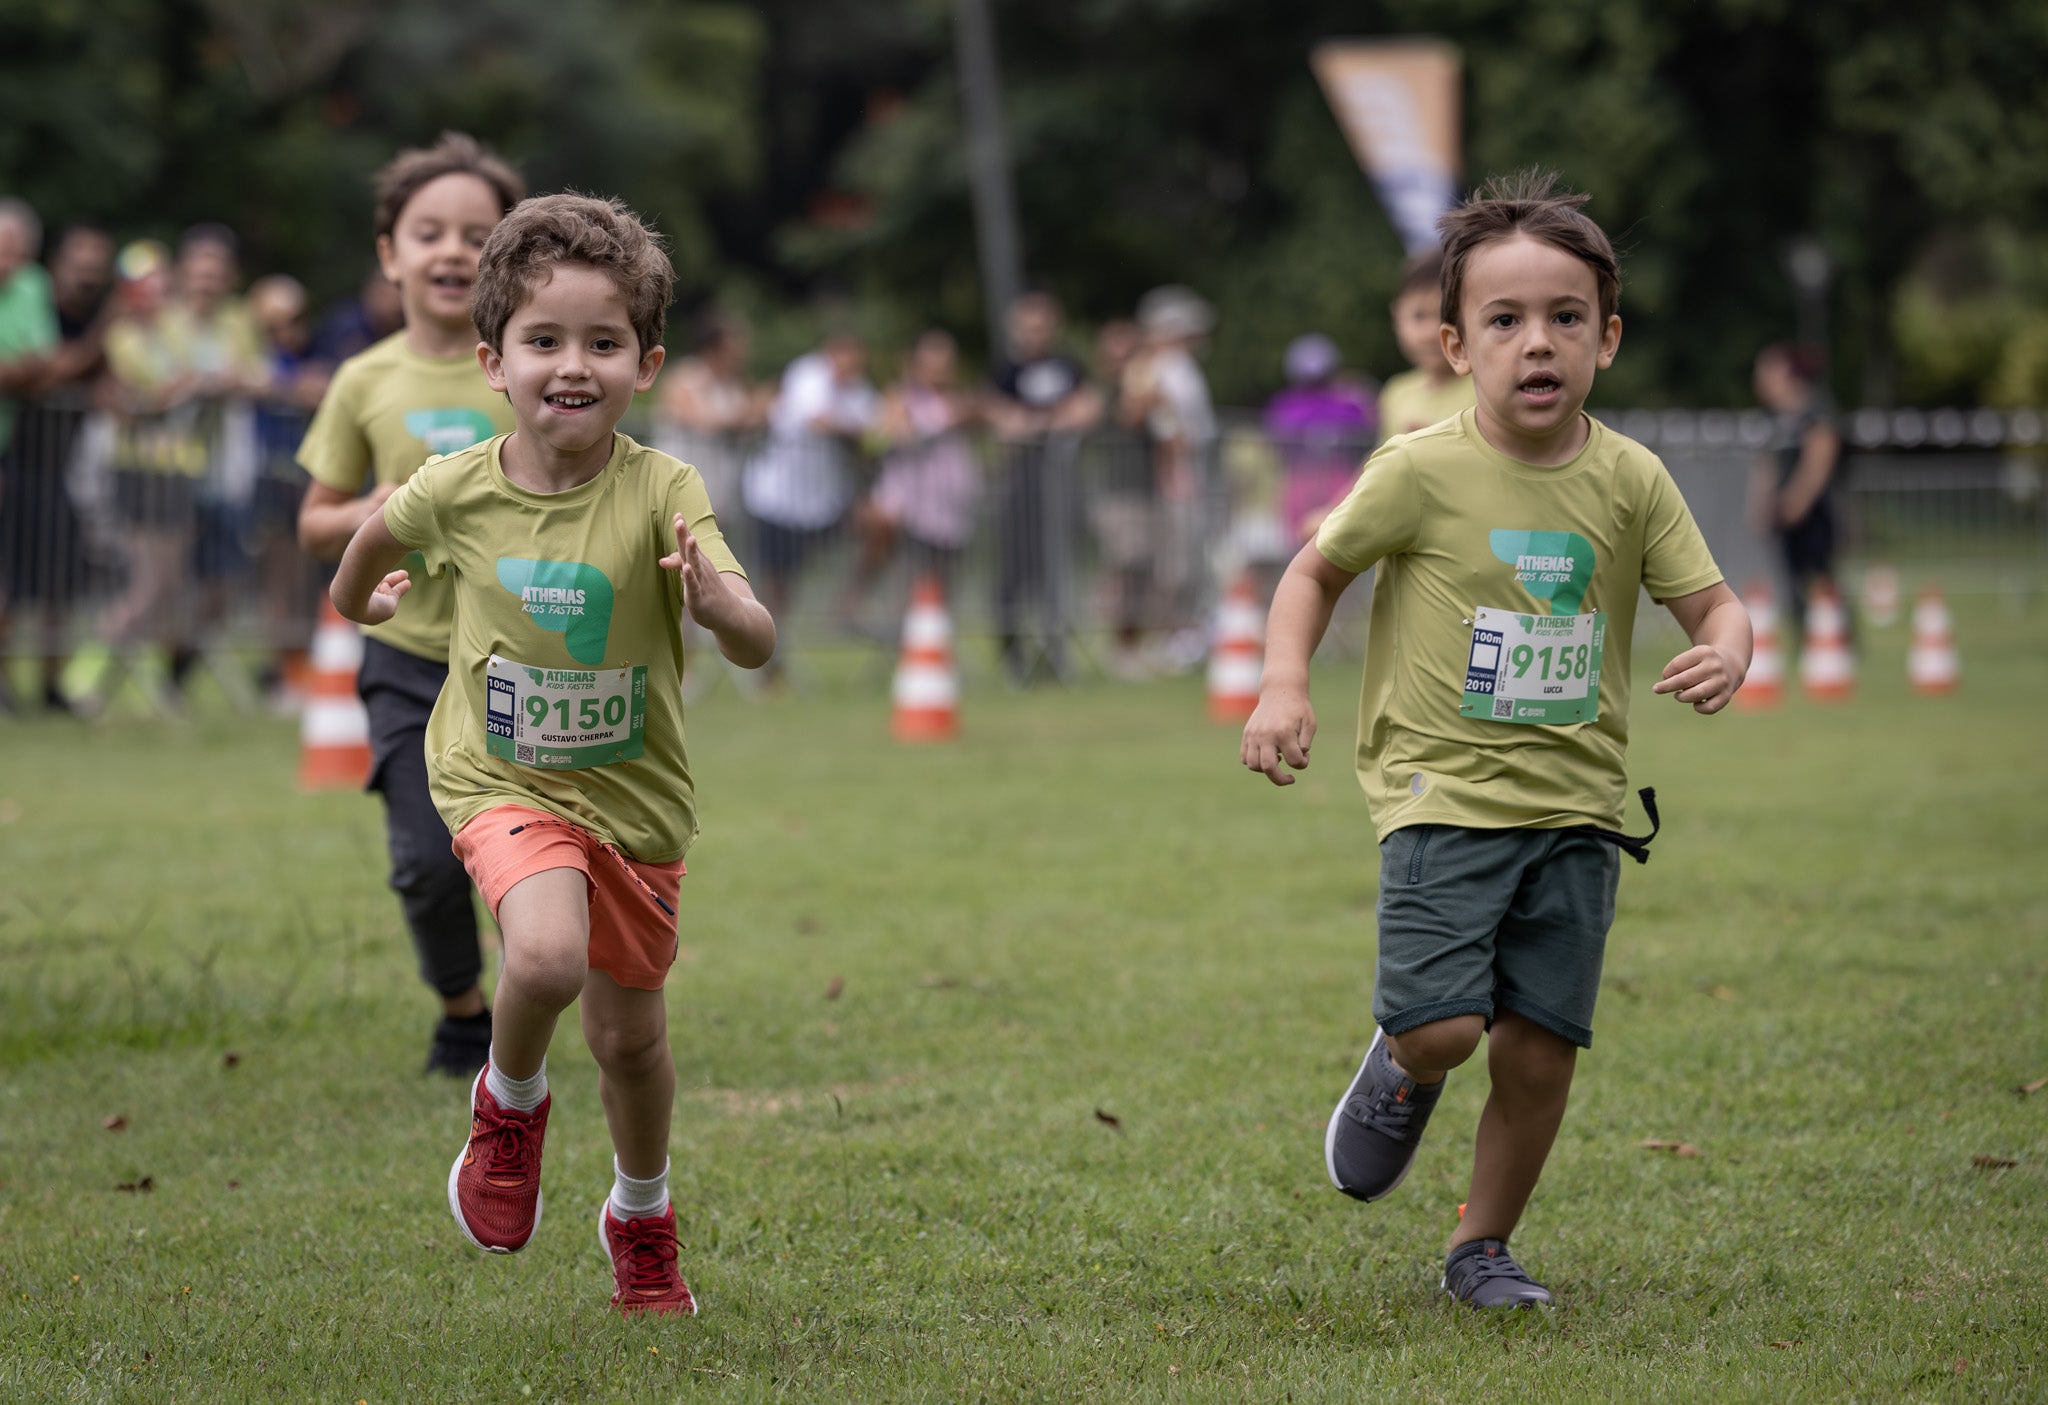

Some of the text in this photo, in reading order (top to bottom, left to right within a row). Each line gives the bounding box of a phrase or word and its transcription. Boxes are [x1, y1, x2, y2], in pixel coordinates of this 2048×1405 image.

[1515, 555, 1575, 572] ATHENAS
[1514, 571, 1571, 583] KIDS FASTER
[521, 586, 586, 605] ATHENAS
[521, 603, 585, 616] KIDS FASTER
[1536, 616, 1576, 628] ATHENAS
[1474, 630, 1502, 645] 100m
[1511, 644, 1589, 681] 9158
[546, 671, 596, 683] ATHENAS
[488, 678, 515, 693] 100m
[1465, 679, 1493, 693] 2019
[1543, 686, 1563, 694] LUCCA
[526, 695, 627, 731] 9150
[487, 721, 512, 737] 2019
[541, 733, 577, 743] GUSTAVO
